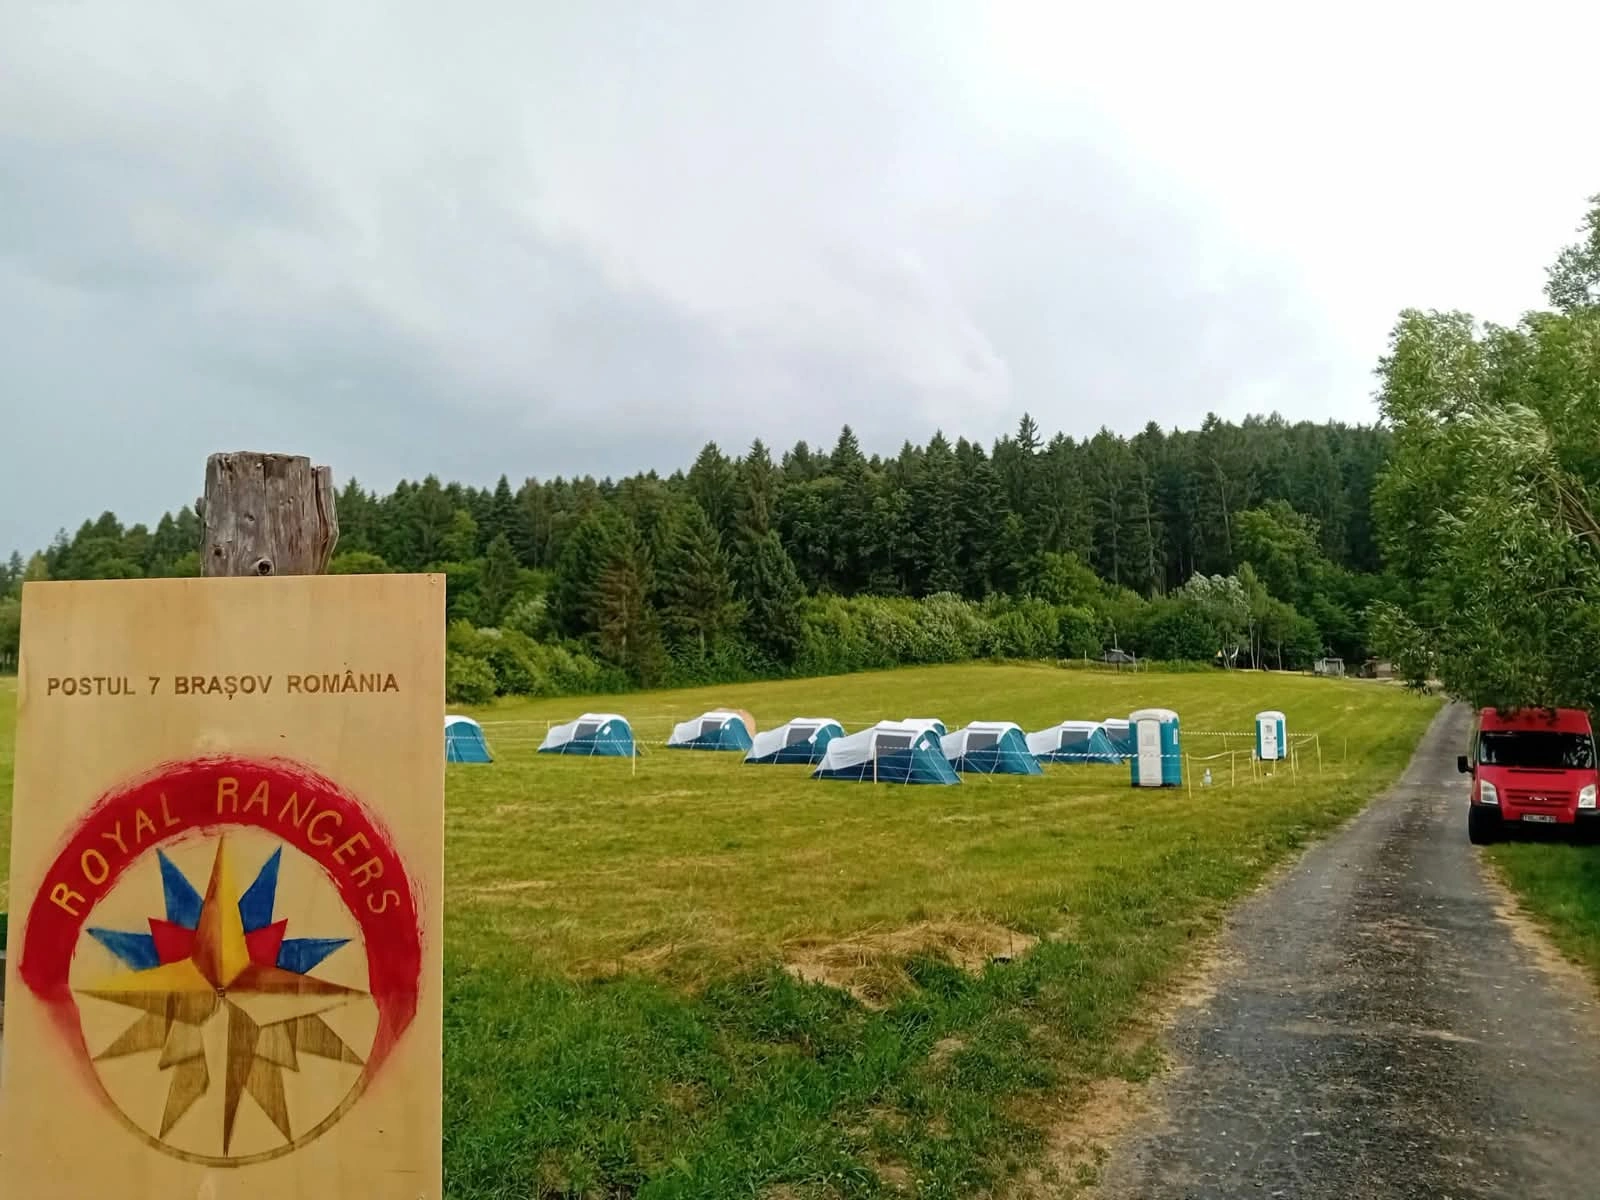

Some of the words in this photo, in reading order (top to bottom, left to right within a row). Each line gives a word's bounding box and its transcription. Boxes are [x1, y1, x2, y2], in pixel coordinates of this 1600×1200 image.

[47, 676, 136, 696] POSTUL
[148, 676, 161, 695] 7
[174, 675, 273, 700] BRAȘOV
[287, 670, 400, 695] ROMÂNIA
[49, 792, 181, 917] ROYAL
[216, 776, 400, 914] RANGERS
